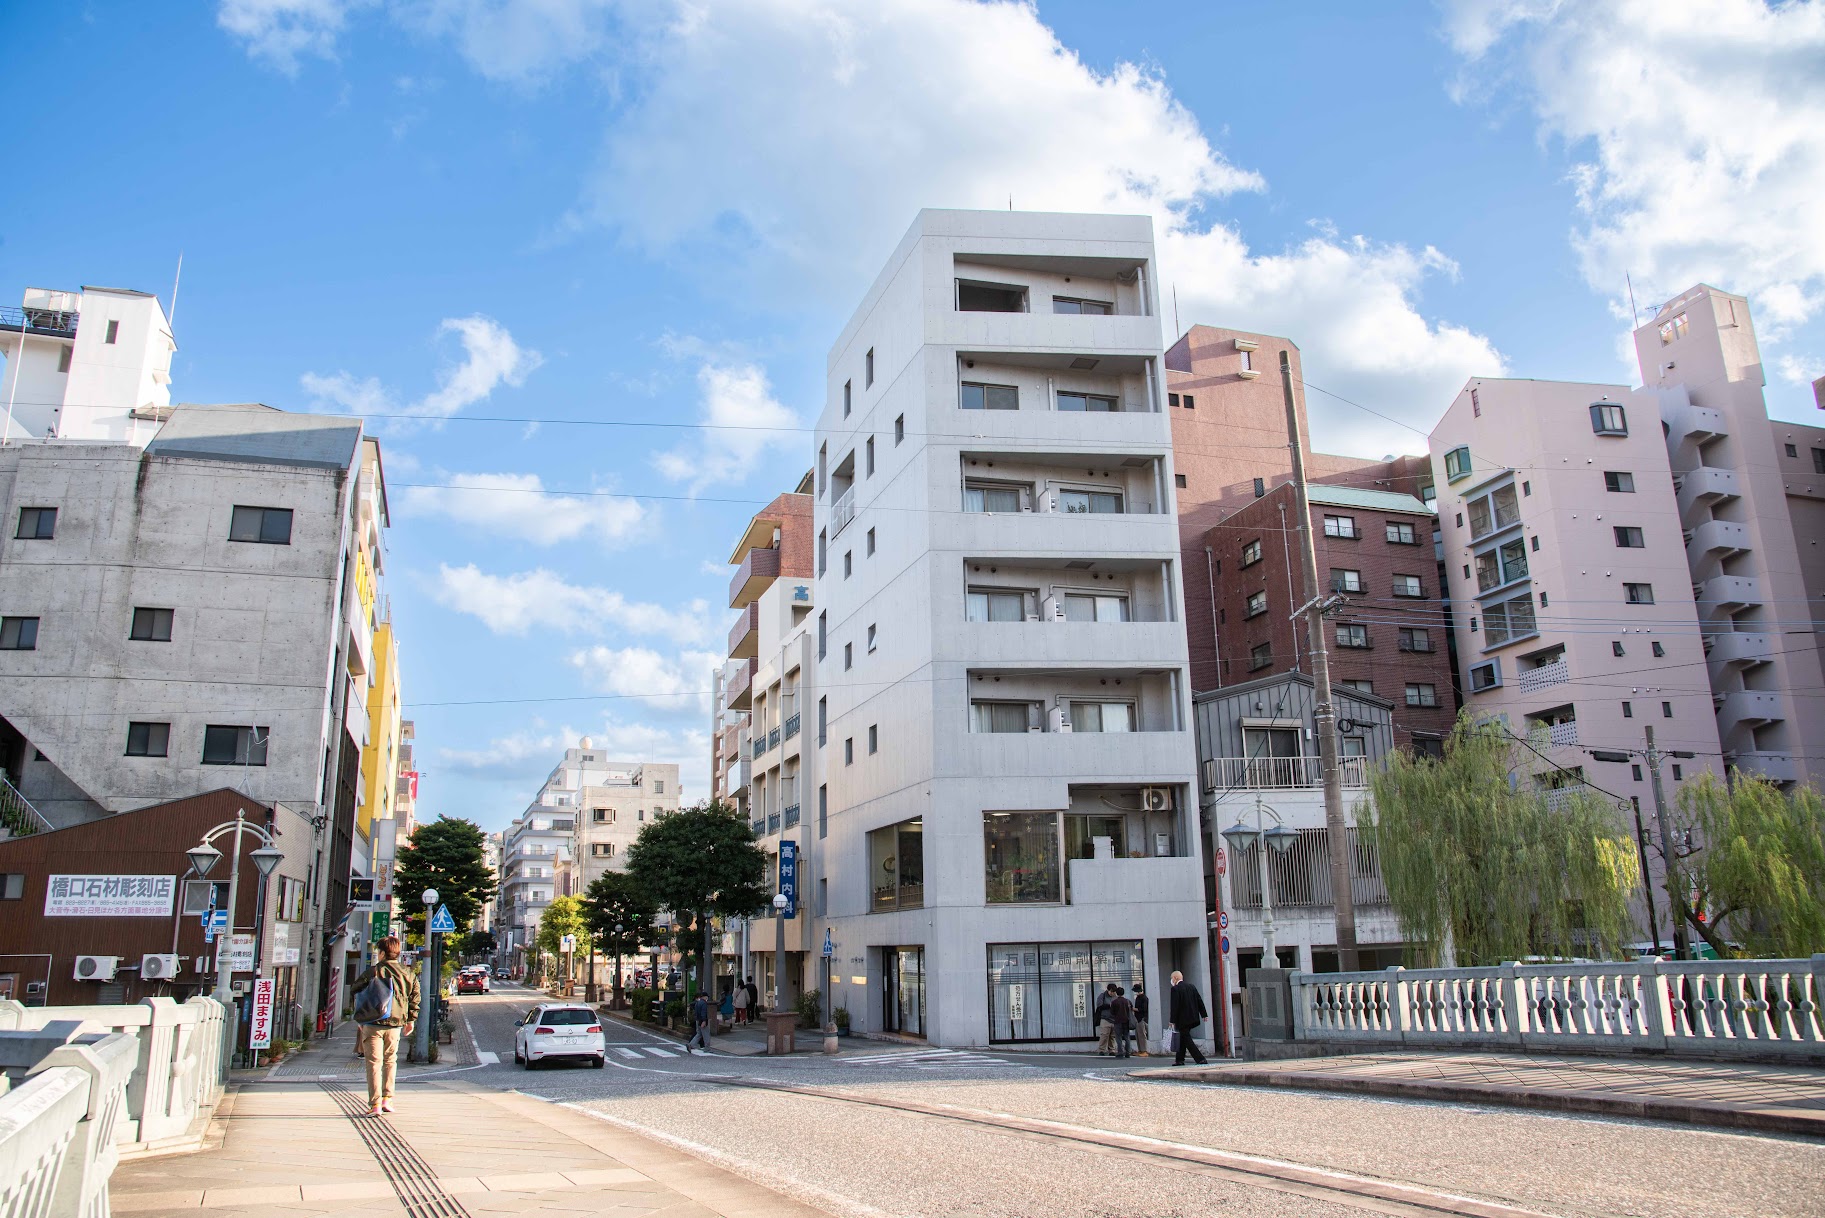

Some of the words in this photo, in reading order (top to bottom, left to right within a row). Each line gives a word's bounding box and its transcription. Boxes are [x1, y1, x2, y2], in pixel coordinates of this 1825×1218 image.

[51, 877, 171, 898] 橋口石材彫刻店
[781, 846, 794, 914] 高村内科
[1006, 950, 1125, 967] 万屋町調剤薬局
[254, 980, 271, 1041] 浅田ますみ
